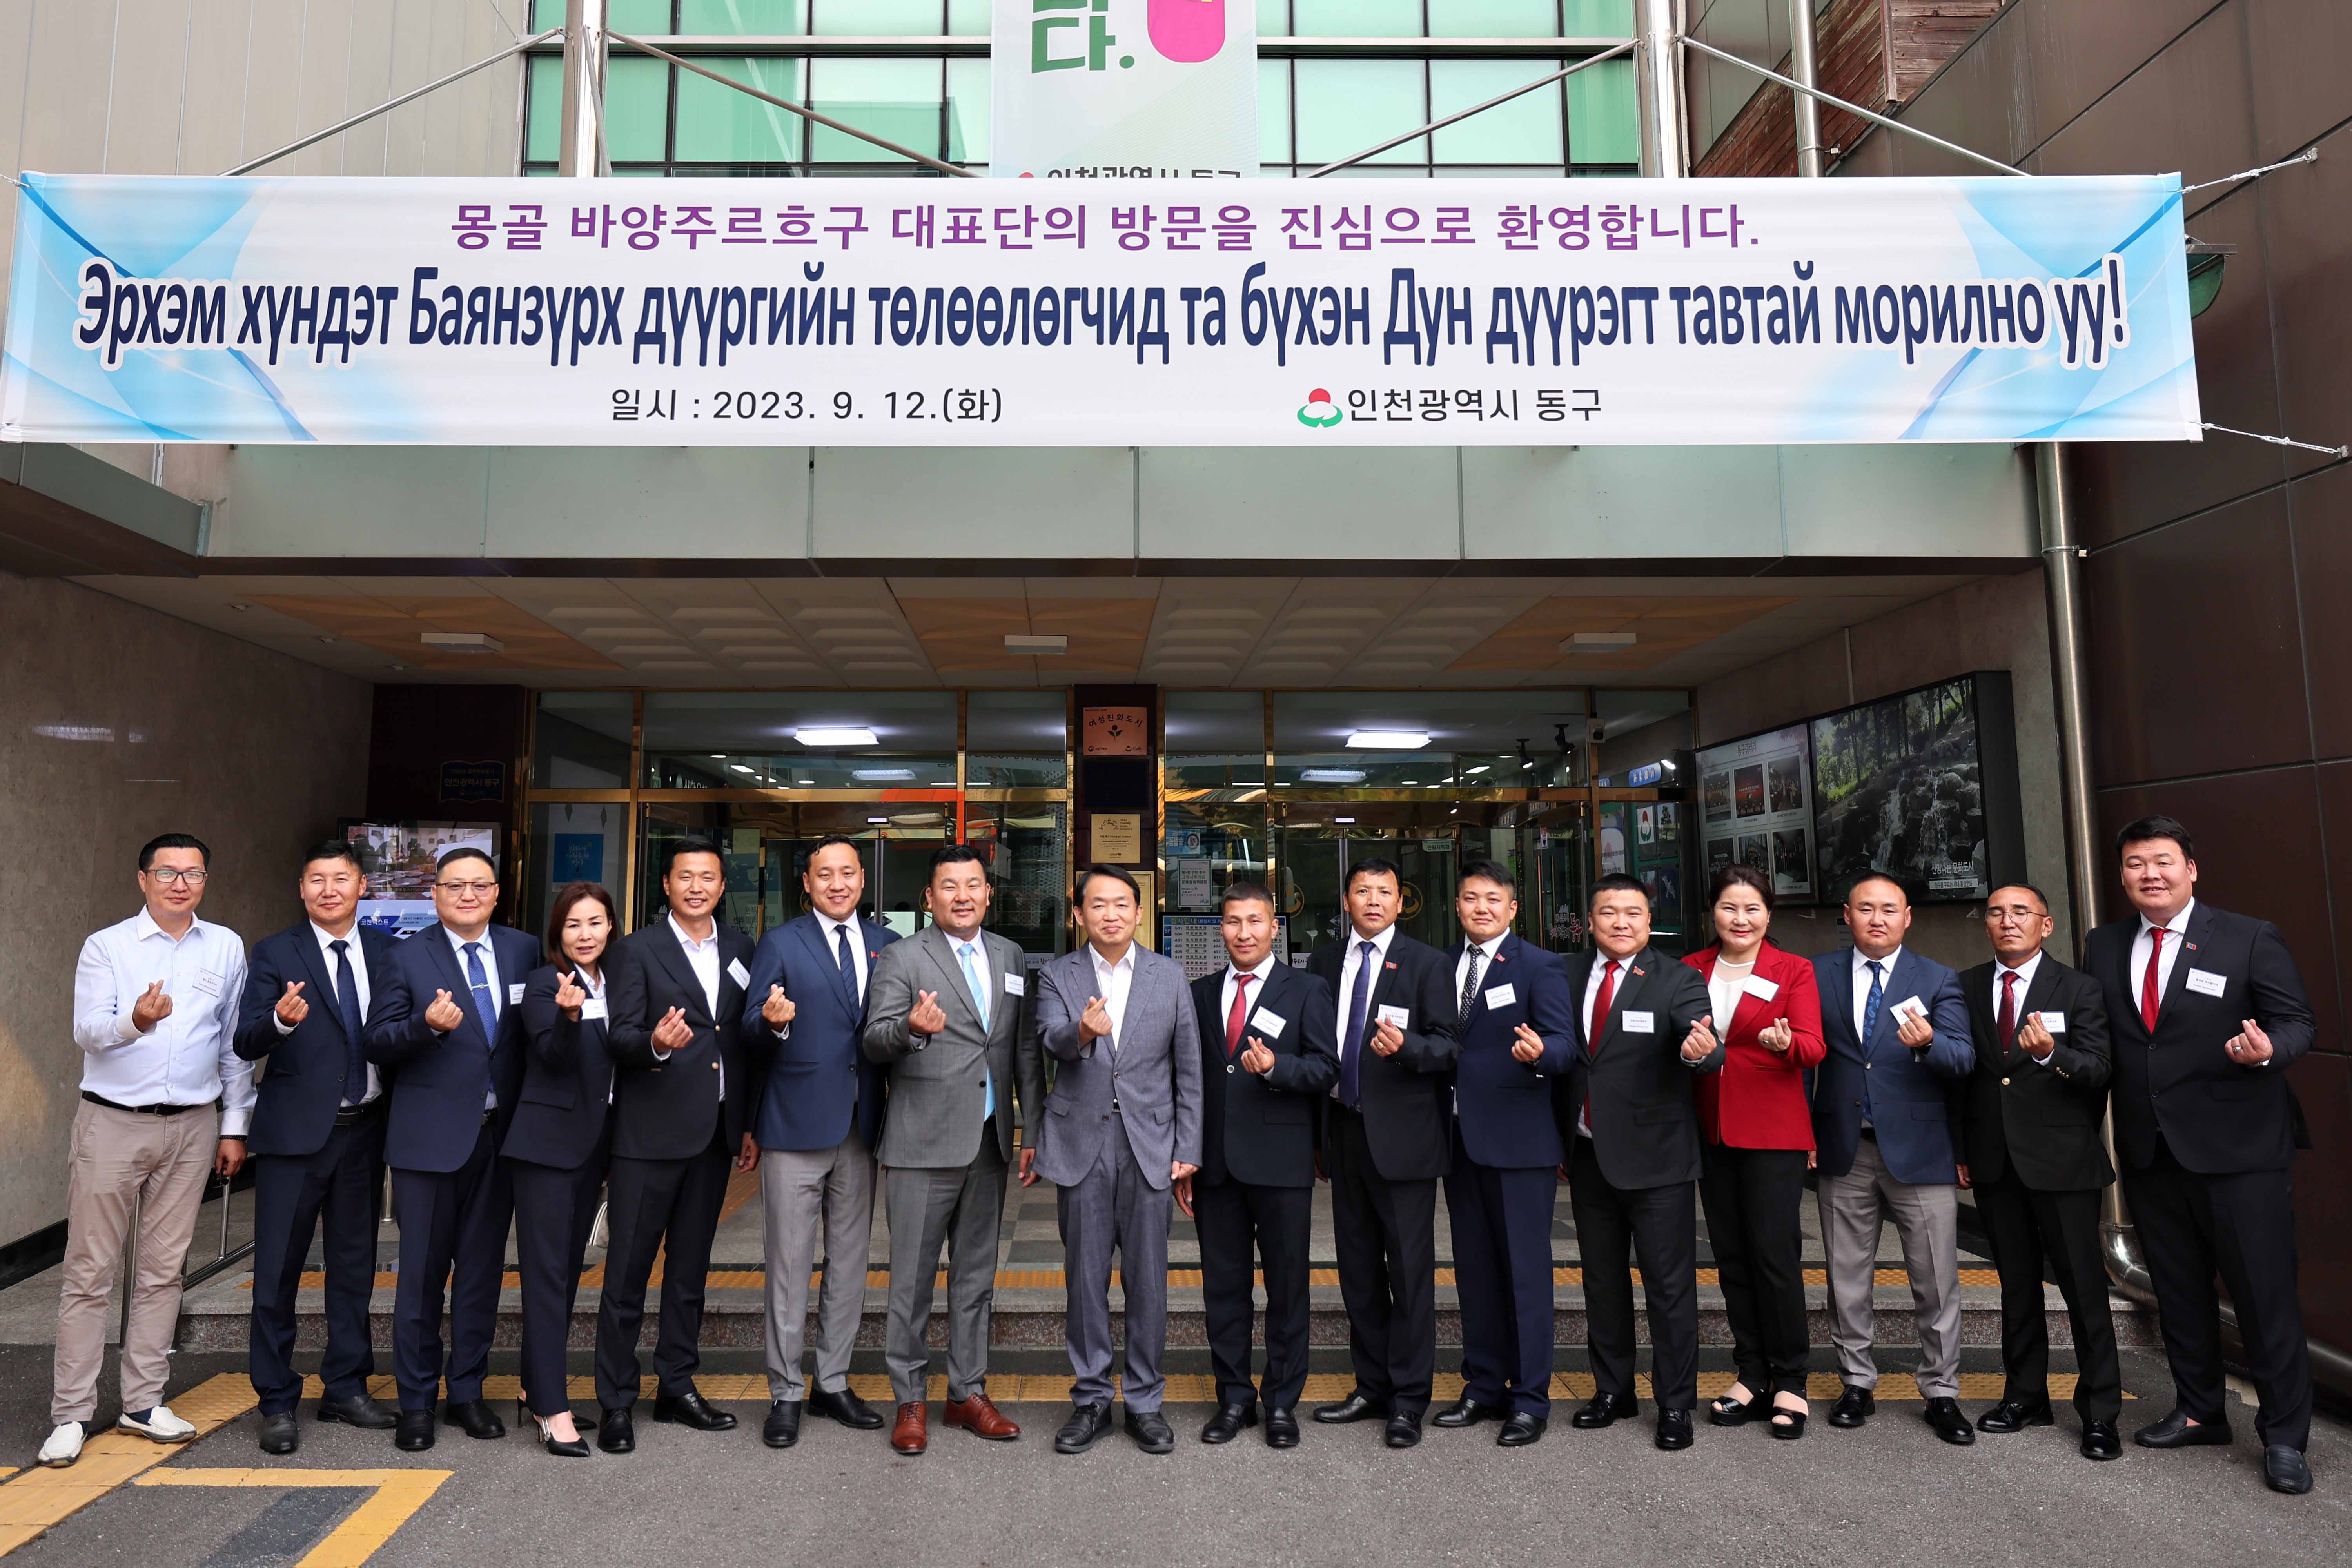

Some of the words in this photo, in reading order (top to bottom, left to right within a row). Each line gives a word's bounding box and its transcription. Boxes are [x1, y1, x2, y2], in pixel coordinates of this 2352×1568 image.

[1031, 15, 1135, 74] 다.
[451, 204, 548, 250] 몽골
[571, 204, 869, 250] 바양주르흐구
[893, 204, 1086, 250] 대표단의
[1112, 205, 1256, 251] 방문을
[1281, 205, 1476, 250] 진심으로
[1498, 204, 1759, 250] 환영합니다.
[79, 263, 226, 365] Эрхэм
[236, 285, 399, 365] хүндэт
[409, 267, 624, 366] Баянзүрх
[633, 261, 855, 367] дүүргийн
[868, 286, 1170, 365] төлөөлөгчид
[1180, 286, 1226, 346] та
[1241, 261, 1370, 367] бүхэн
[1383, 268, 1472, 367] Дун
[1486, 285, 1659, 367] дүүрэгт
[1669, 260, 1821, 345] тавтай
[1835, 283, 2045, 365] морилно
[612, 389, 677, 421] 일시
[693, 399, 699, 418] :
[713, 391, 815, 419] 2023.
[833, 391, 863, 419] 9.
[885, 388, 1002, 423] 12.(화)
[1348, 389, 1518, 421] 인천광역시
[1536, 390, 1602, 421] 동구
[1089, 713, 1142, 727] 여성친화도시
[1931, 862, 1952, 875] 신명나는
[1953, 860, 1974, 873] 문화도시
